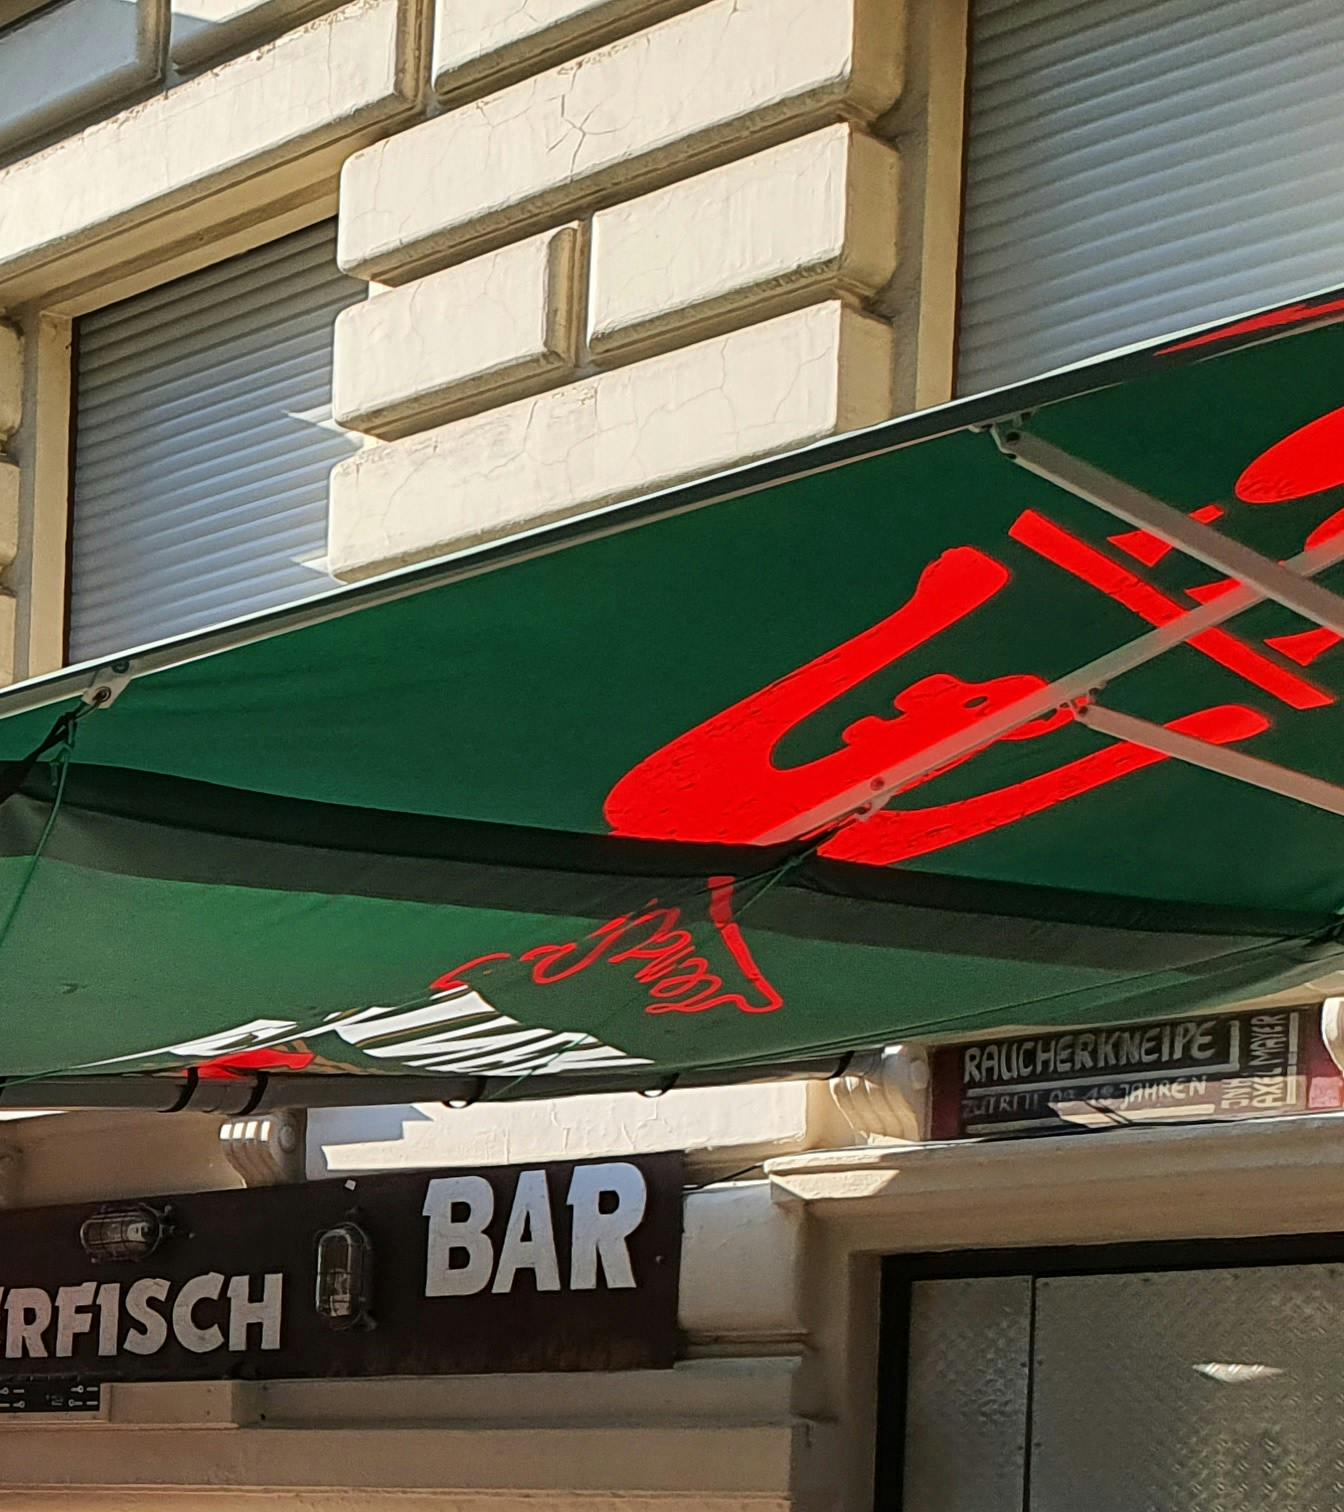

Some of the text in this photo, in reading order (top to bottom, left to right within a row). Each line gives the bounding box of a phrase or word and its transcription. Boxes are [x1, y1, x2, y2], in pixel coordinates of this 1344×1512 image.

[962, 1020, 1217, 1085] RAUCHERKNEIPE
[1248, 1013, 1286, 1108] AXEL MAYER
[1119, 1075, 1209, 1111] JAHREN
[422, 1162, 647, 1297] BAR
